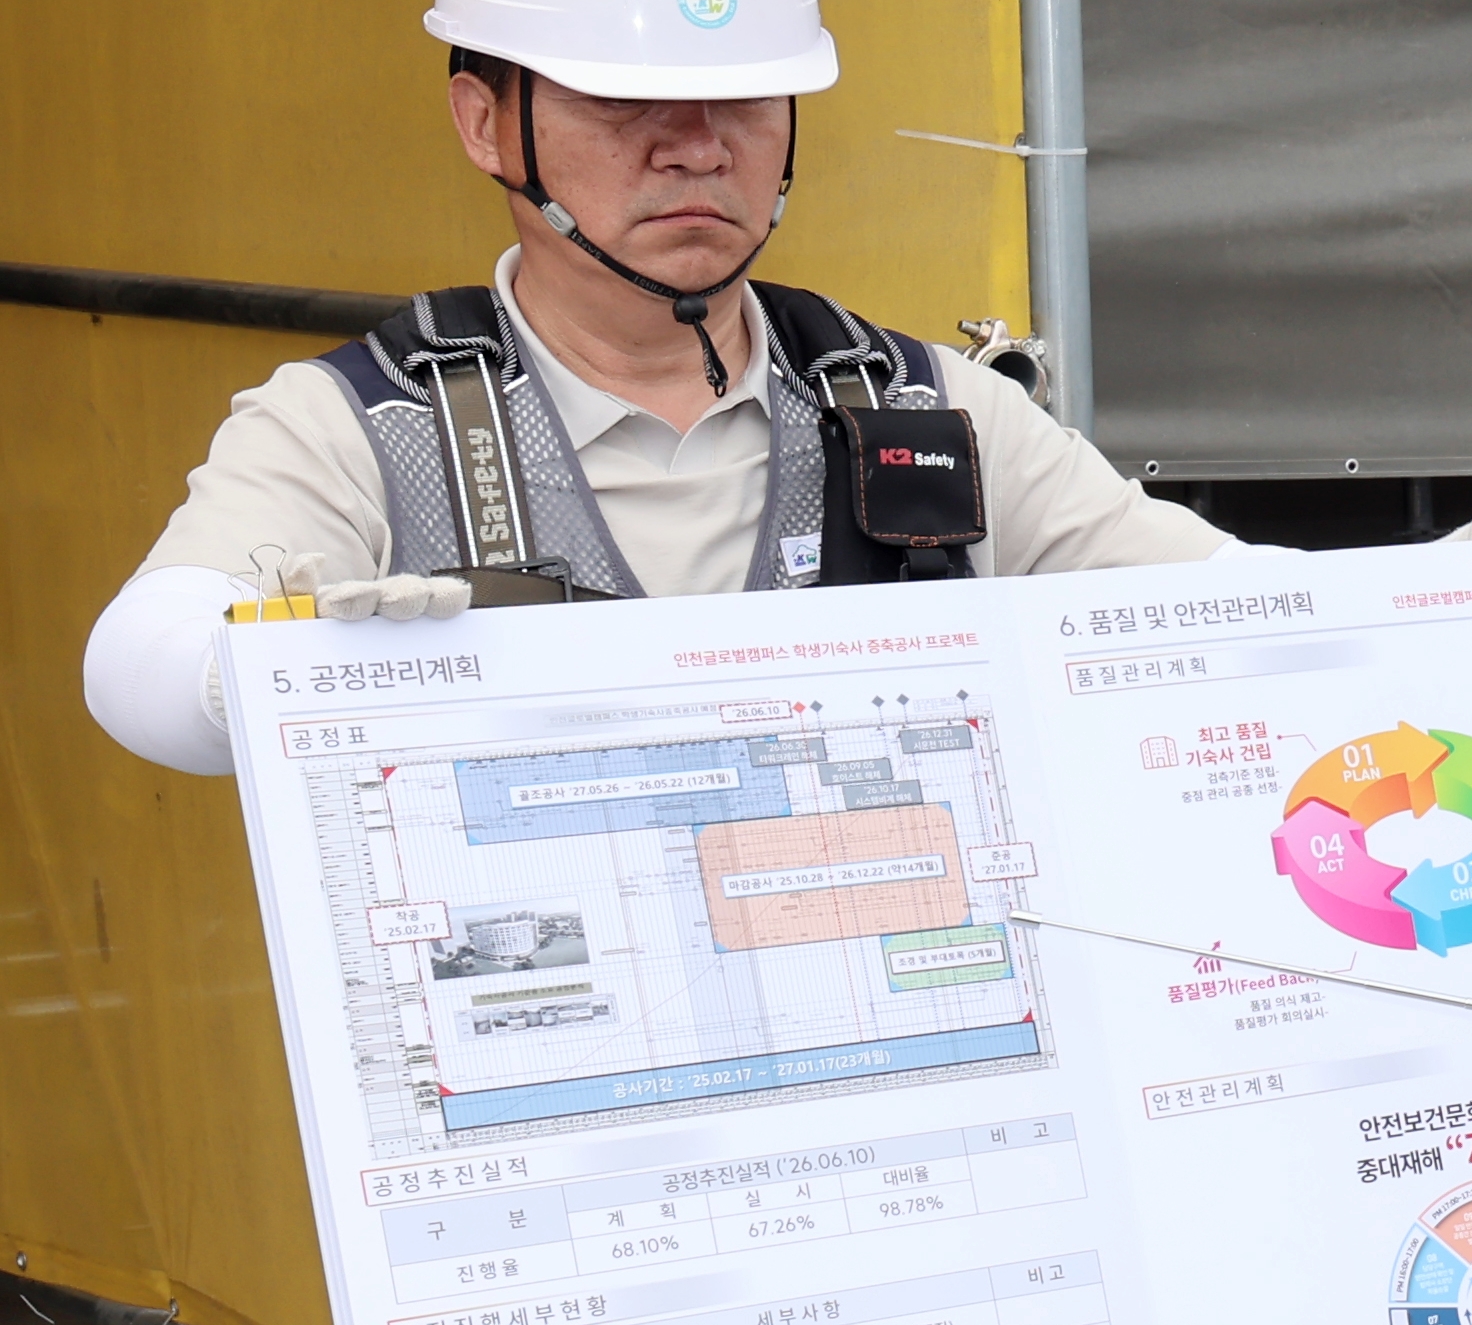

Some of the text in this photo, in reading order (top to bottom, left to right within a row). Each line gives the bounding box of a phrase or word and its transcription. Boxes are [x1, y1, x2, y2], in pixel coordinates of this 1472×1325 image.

[880, 448, 955, 470] K2 Safety
[1059, 591, 1313, 637] 6. 품질 및 안전관리계획
[674, 632, 979, 668] 인천글로벌캠퍼스 학생기숙사 증축공사 프로젝트
[273, 655, 481, 694] 5. 공정관리계획
[1198, 721, 1268, 744] 최고 품질
[1186, 742, 1272, 767] 기숙사 건립
[1343, 743, 1373, 768] 01
[1342, 767, 1381, 783] PLAN
[991, 849, 1011, 862] 준공
[1310, 833, 1345, 859] 04
[1317, 857, 1344, 874] ACT
[1168, 975, 1275, 1004] 품질평가(Feed
[882, 1165, 929, 1186] 대비율
[1357, 1147, 1443, 1183] 중대재해
[879, 1195, 944, 1218] 98.78%
[748, 1215, 815, 1238] 67.26%
[612, 1235, 679, 1259] 68.10%
